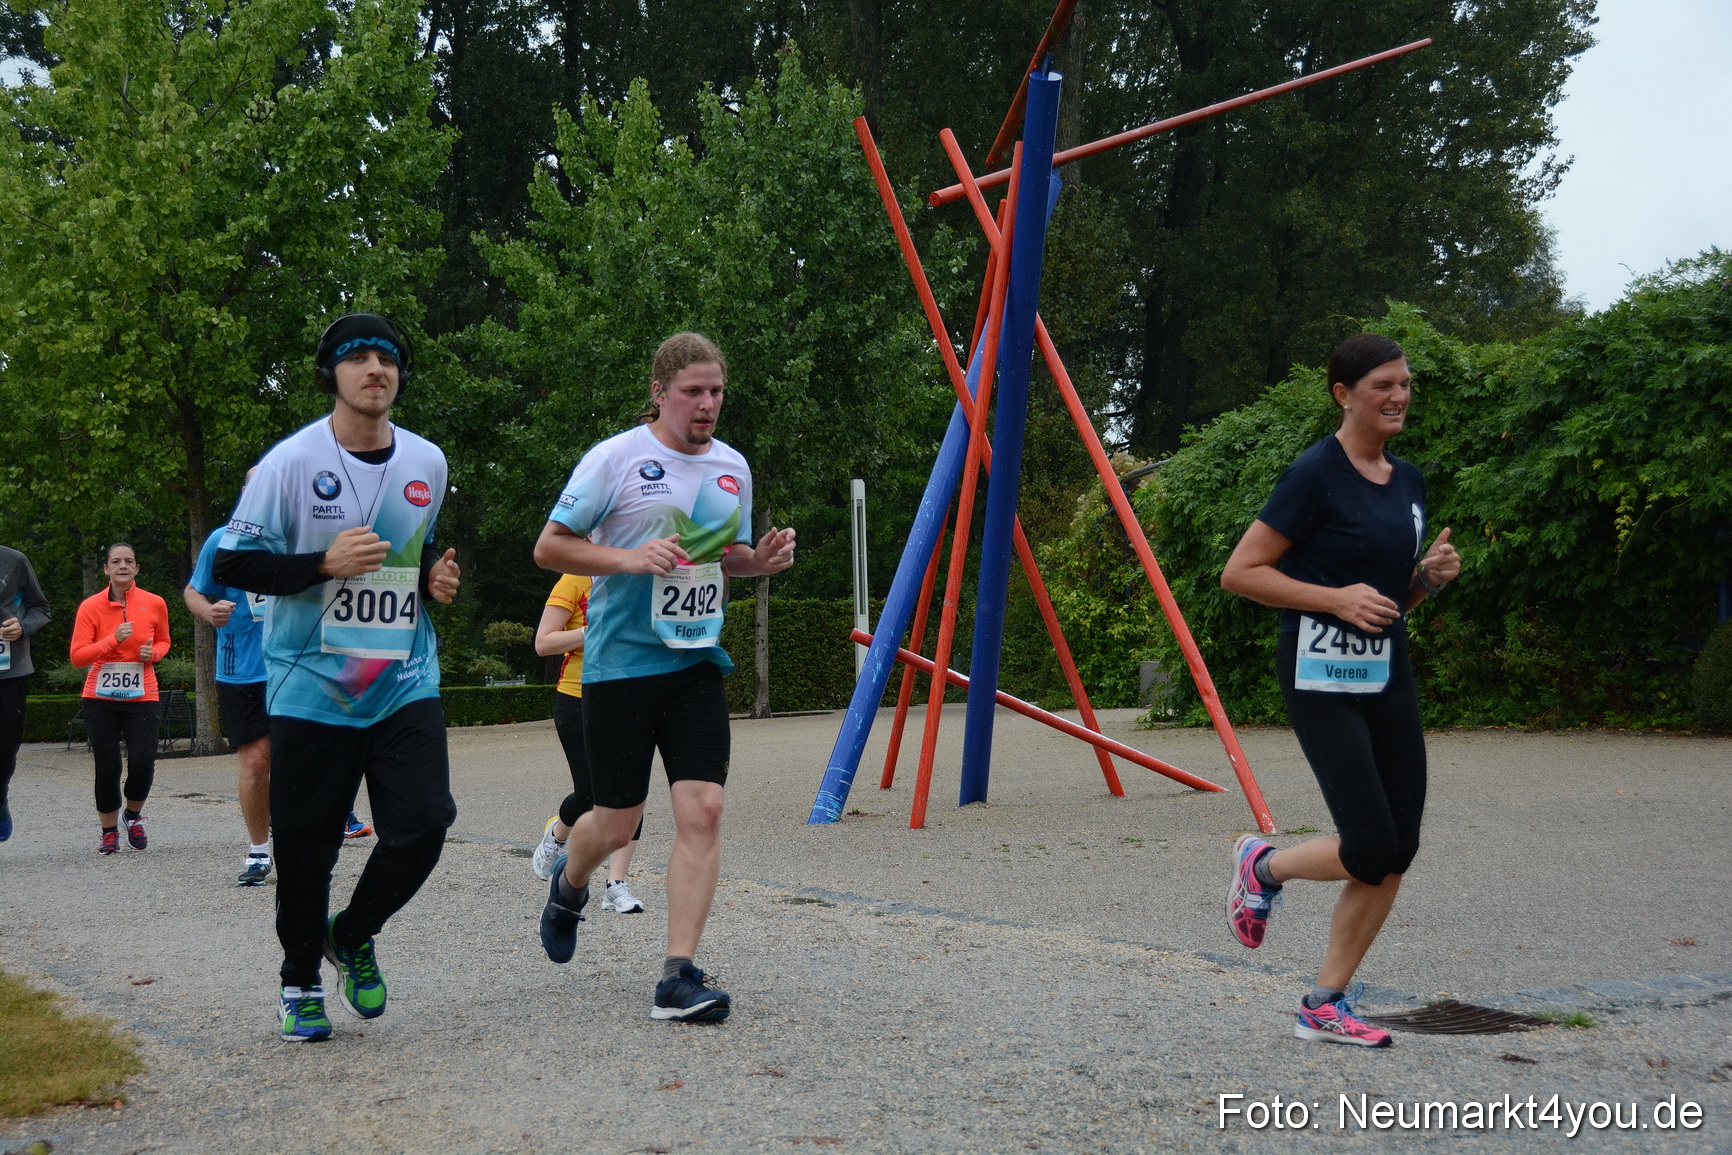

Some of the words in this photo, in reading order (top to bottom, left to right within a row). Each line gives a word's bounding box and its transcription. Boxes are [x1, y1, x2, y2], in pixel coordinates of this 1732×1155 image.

[640, 483, 671, 491] PARTL
[312, 505, 345, 514] PARTL
[372, 571, 416, 582] BOCK
[334, 588, 416, 624] 3004
[661, 583, 717, 617] 2492
[675, 624, 707, 638] Florian
[1325, 664, 1368, 679] Verena
[102, 672, 140, 688] 2564
